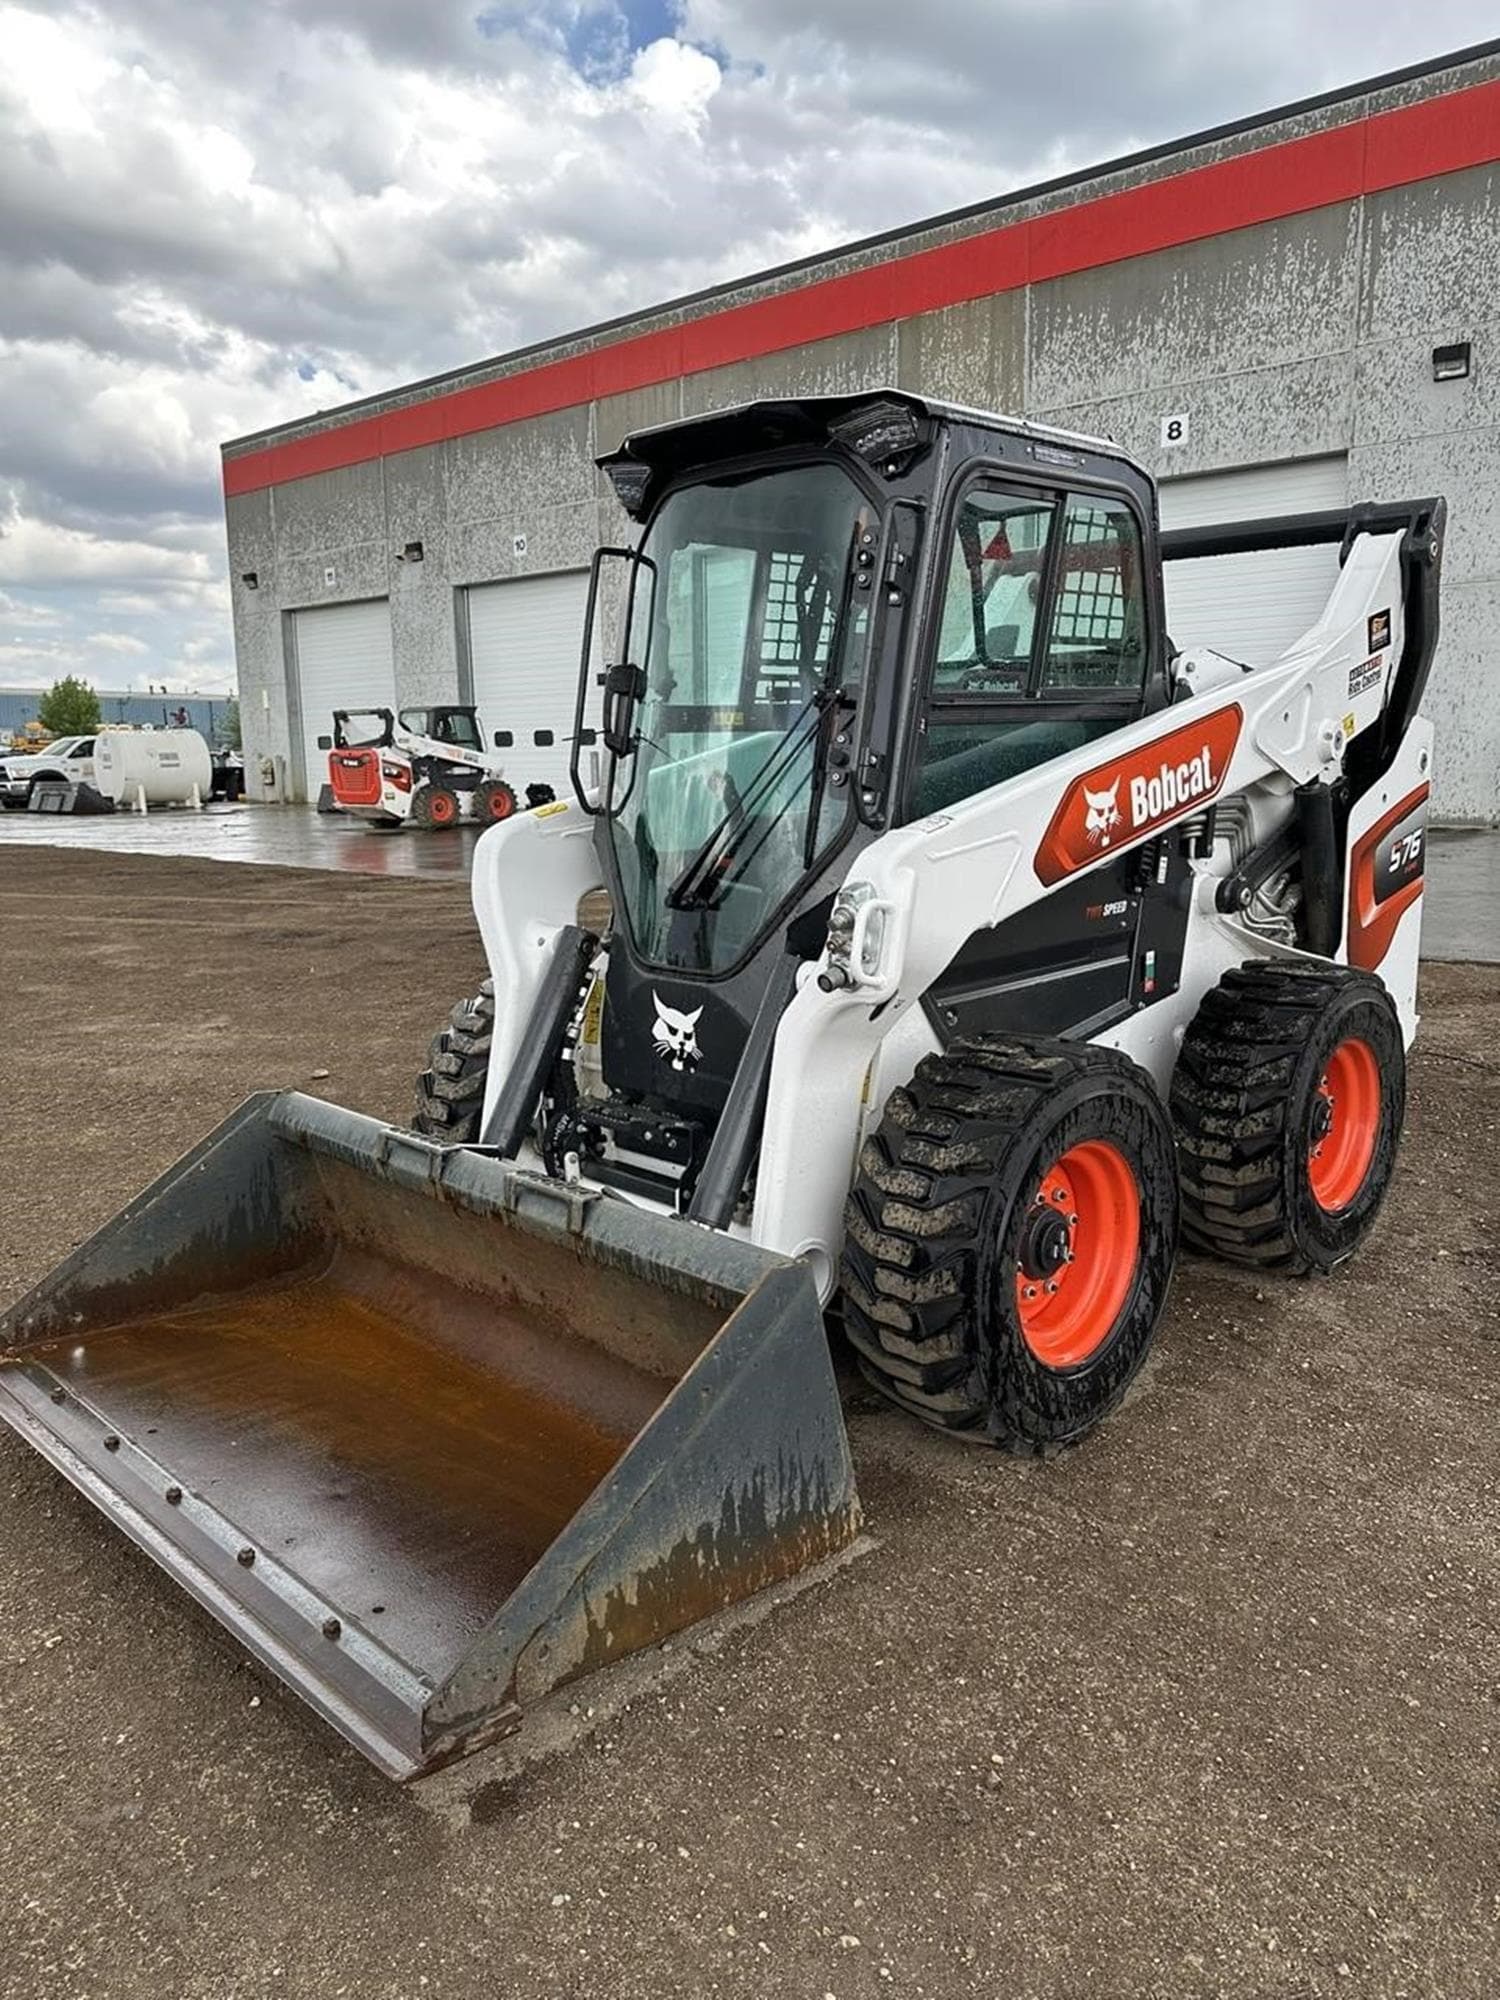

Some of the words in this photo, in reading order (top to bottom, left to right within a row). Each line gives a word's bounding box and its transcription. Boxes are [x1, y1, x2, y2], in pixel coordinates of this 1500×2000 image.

[1167, 420, 1182, 441] 8
[515, 539, 526, 552] 10
[1130, 744, 1212, 828] Bobcat
[1103, 900, 1128, 917] SPEED
